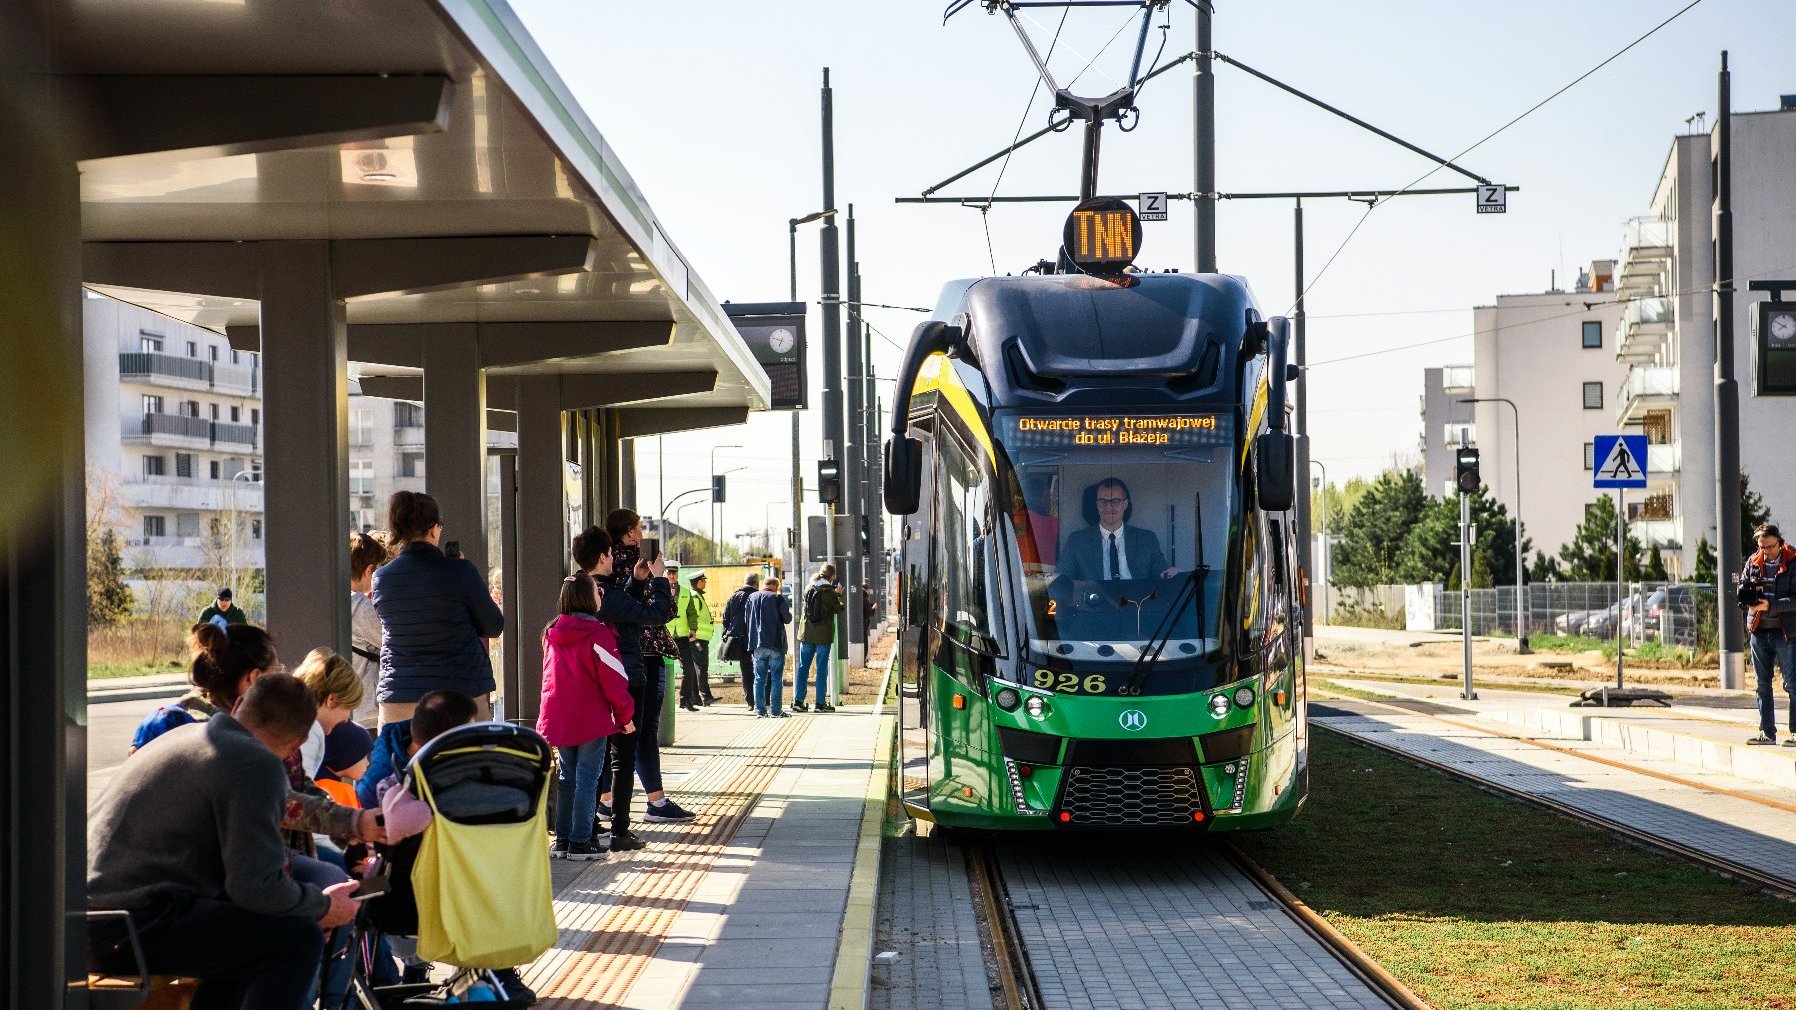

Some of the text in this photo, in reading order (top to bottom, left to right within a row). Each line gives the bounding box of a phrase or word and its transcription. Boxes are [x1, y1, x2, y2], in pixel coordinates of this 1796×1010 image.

[1485, 188, 1498, 202] Z
[1147, 196, 1160, 210] Z
[1073, 211, 1133, 258] TNN
[1019, 415, 1216, 432] Otwarcie trasy tramwajowej
[1075, 430, 1168, 445] do ul. Błażeja
[1048, 599, 1057, 614] 2
[1034, 669, 1107, 694] 926
